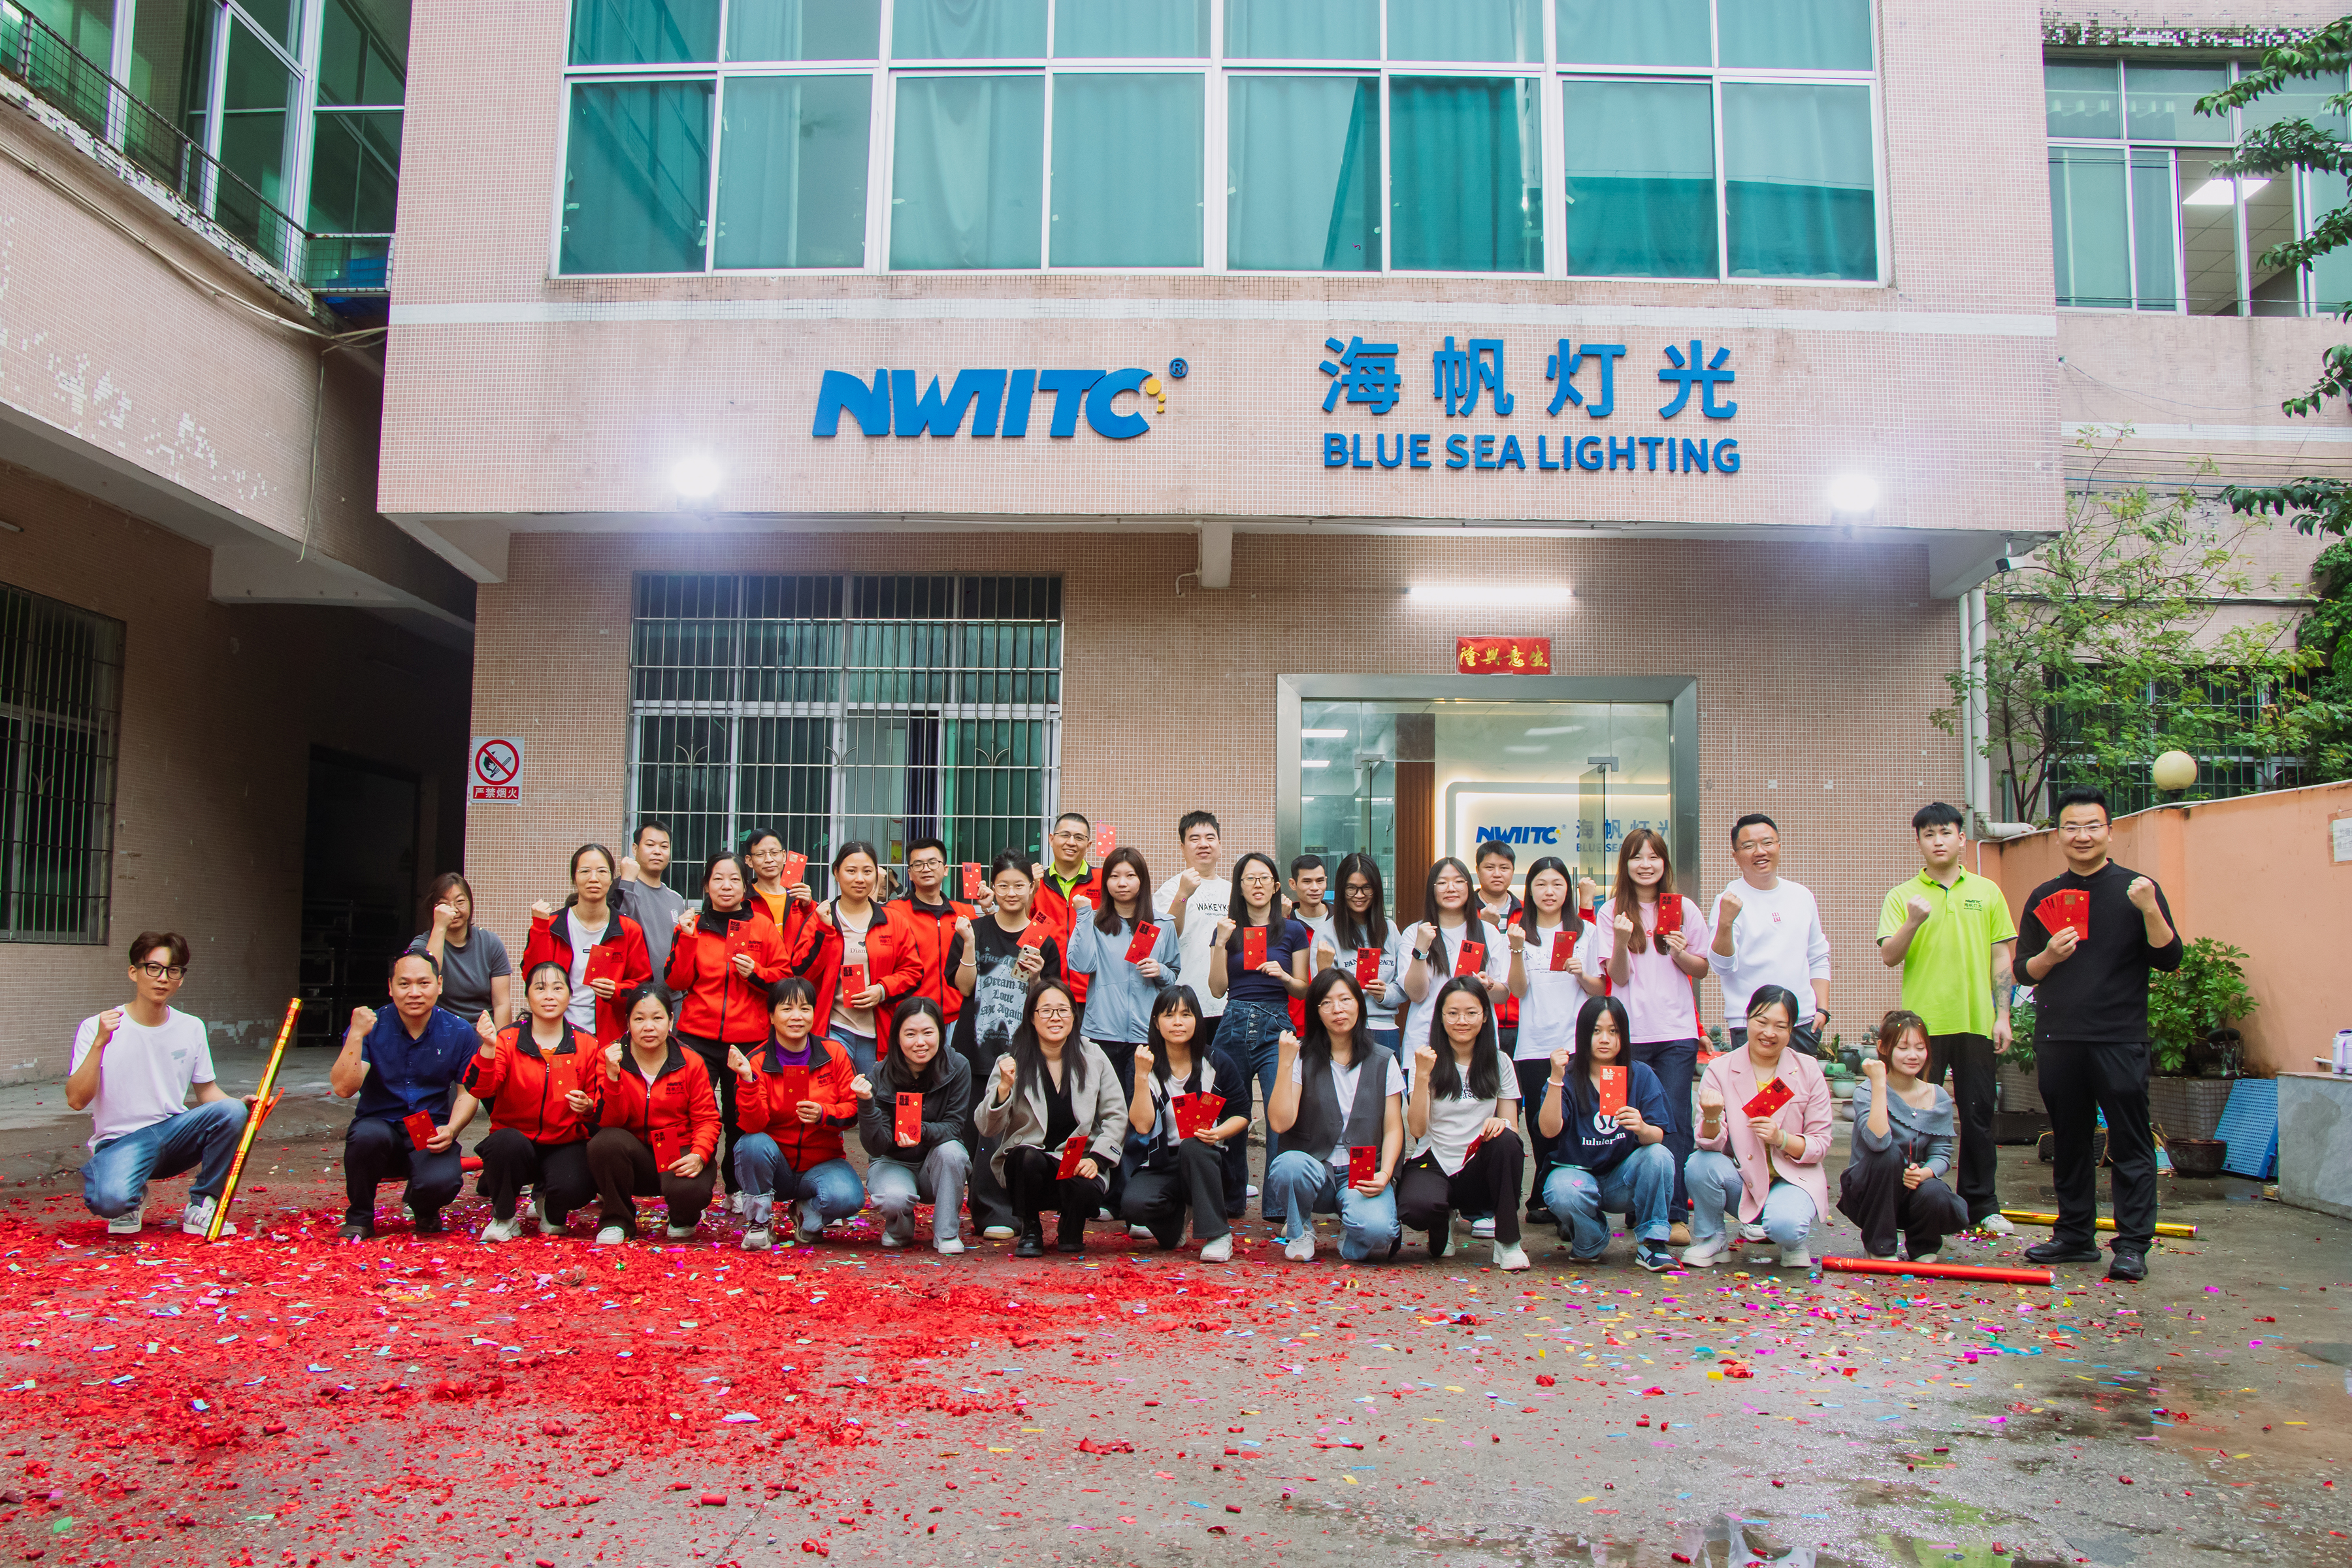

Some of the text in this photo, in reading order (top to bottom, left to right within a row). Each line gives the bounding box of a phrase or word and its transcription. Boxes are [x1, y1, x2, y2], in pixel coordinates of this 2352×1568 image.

[1319, 336, 1738, 419] 海帆灯光
[1324, 433, 1740, 472] BLUE SEA LIGHTING
[474, 787, 517, 798] 严禁烟火
[1576, 843, 1602, 852] BLUE
[997, 1003, 1022, 1021] Again
